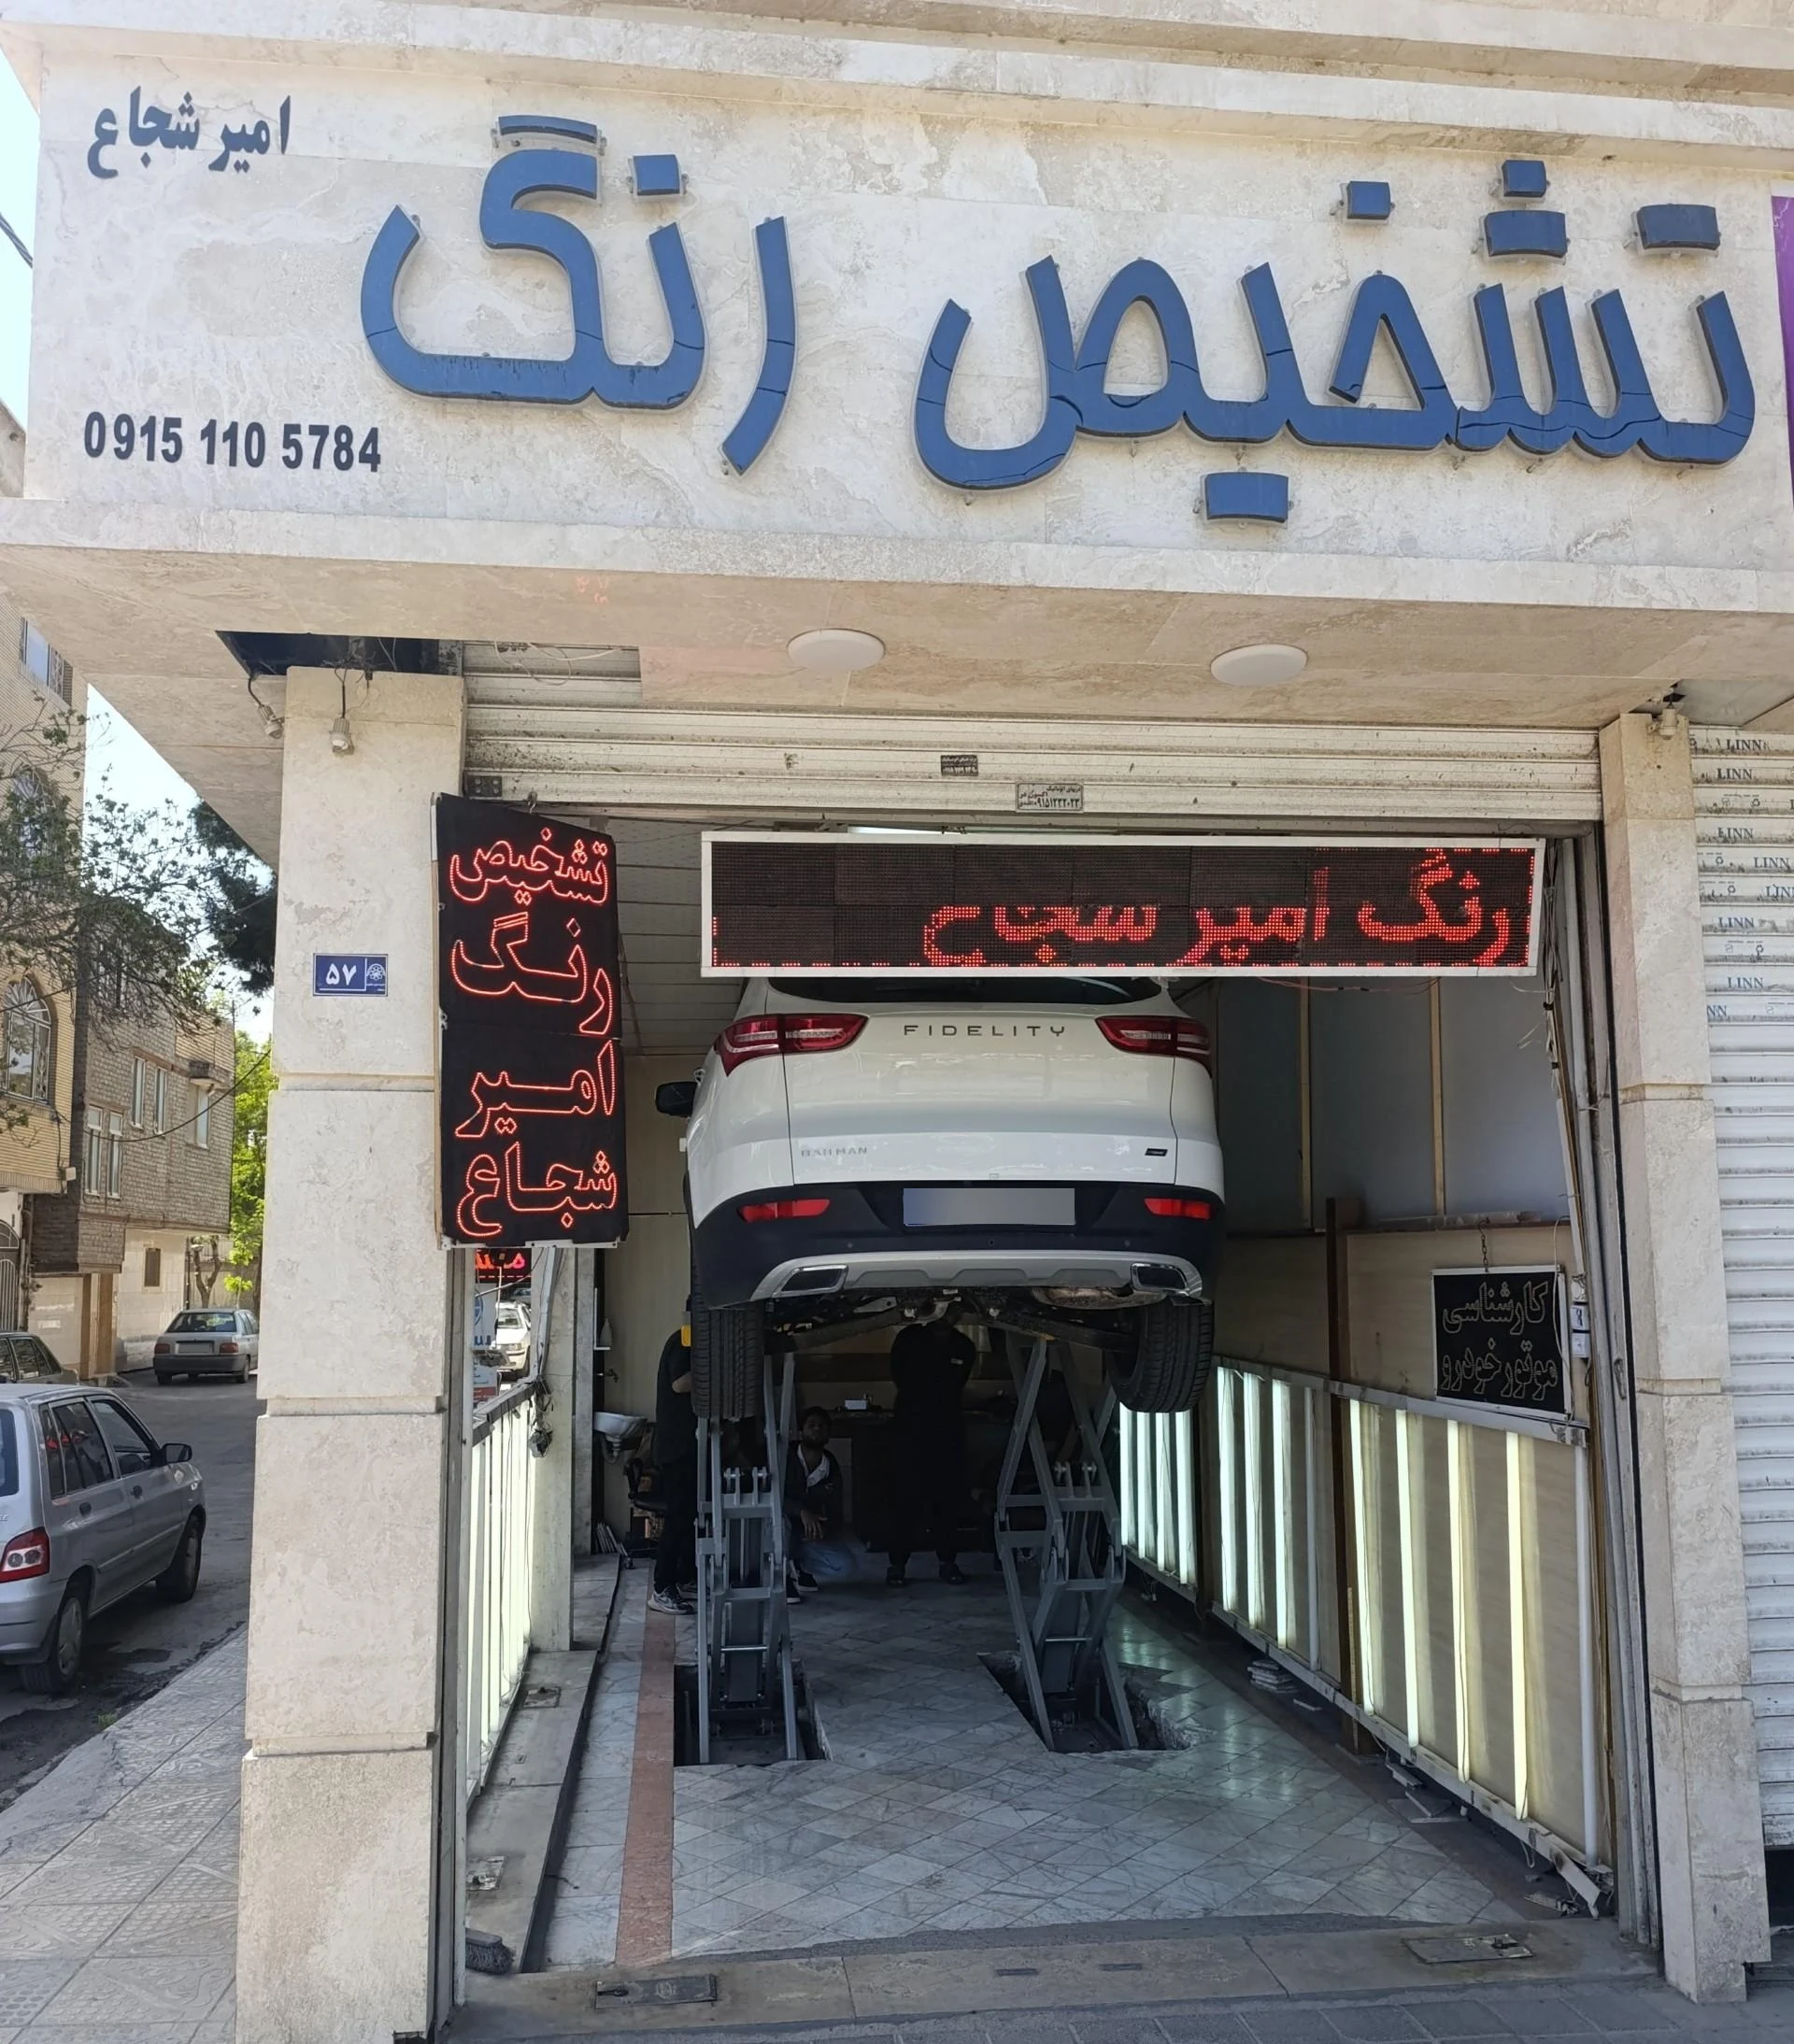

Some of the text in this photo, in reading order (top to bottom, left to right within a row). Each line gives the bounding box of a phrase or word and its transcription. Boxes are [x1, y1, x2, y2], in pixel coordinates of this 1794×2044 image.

[87, 85, 291, 179] امیر شجاع
[361, 115, 1756, 523] تشخیص رنگ
[84, 411, 381, 473] 0915 110 5784
[1717, 768, 1753, 780] LINN
[450, 828, 608, 904] تشخیص
[1754, 857, 1789, 869] LINN
[1358, 850, 1510, 967] رنگ
[1718, 917, 1755, 929] LINN
[325, 963, 357, 986] ۵۷
[450, 912, 614, 1035] رنگ
[1727, 977, 1764, 989] LINN
[904, 1025, 1066, 1038] FIDELITY
[455, 1039, 616, 1138] امیر
[456, 1141, 618, 1237] شجاع
[1443, 1281, 1548, 1335] کارشناسی
[1440, 1338, 1559, 1400] موتور خودرو
